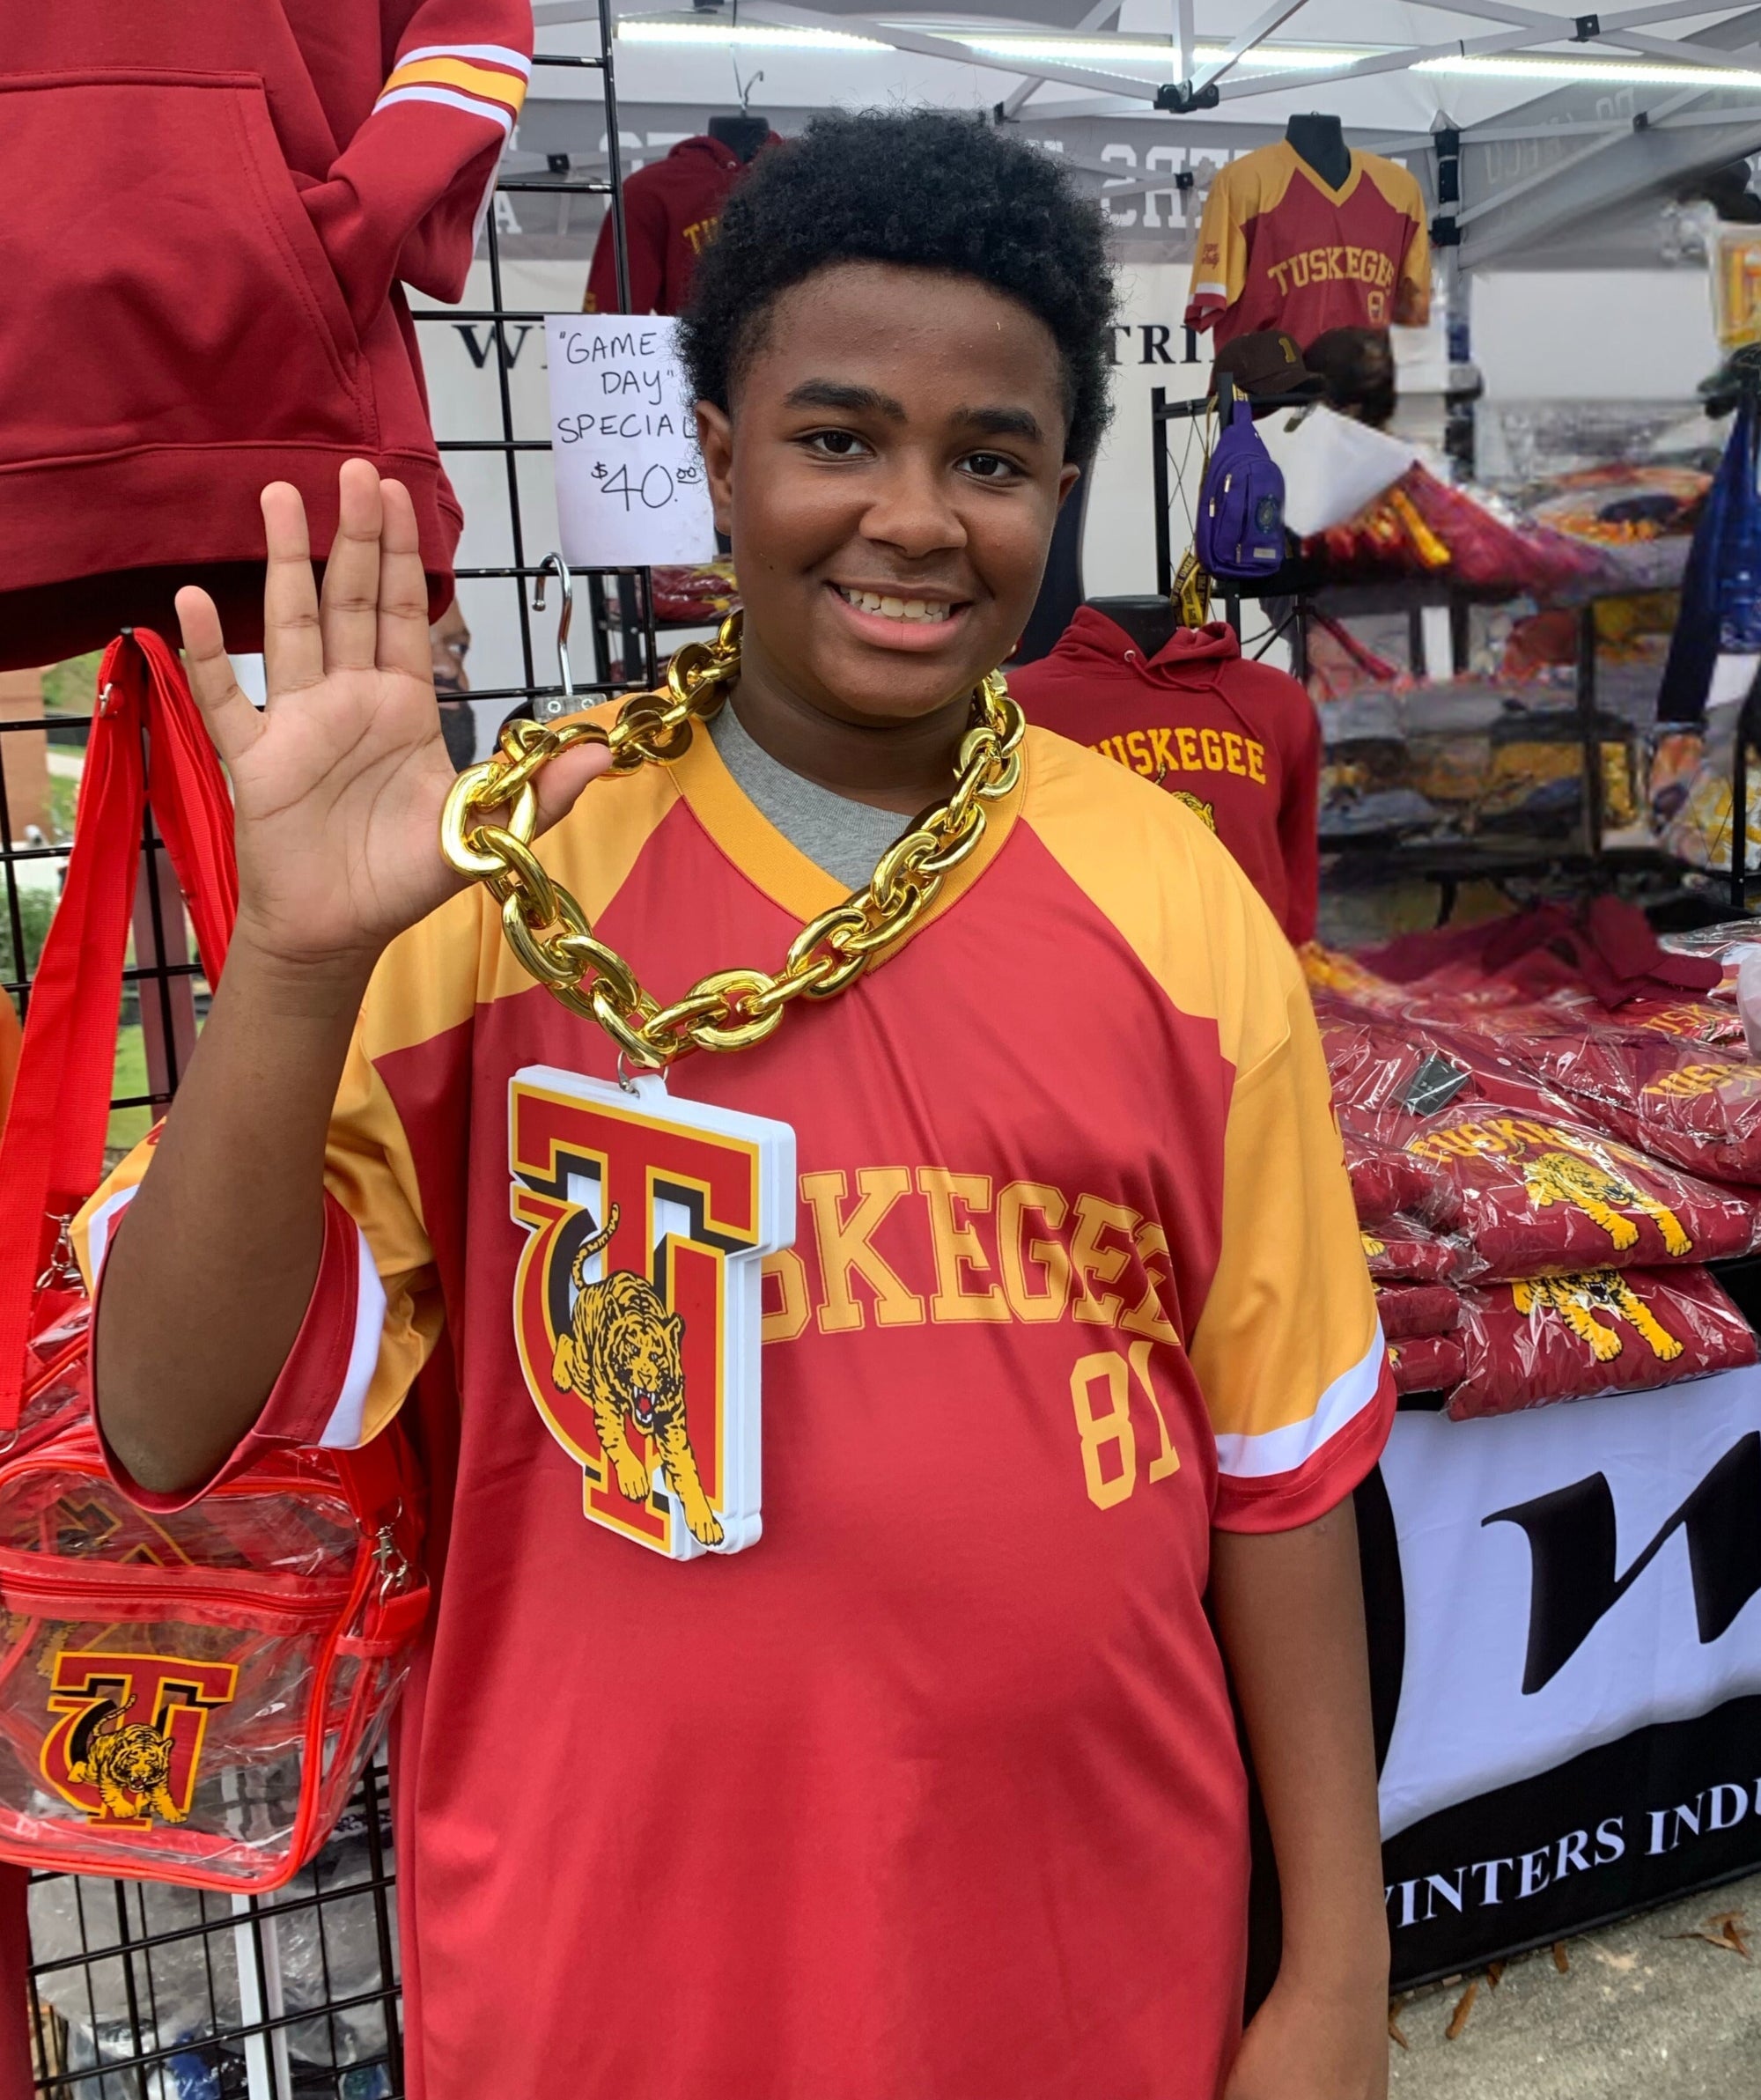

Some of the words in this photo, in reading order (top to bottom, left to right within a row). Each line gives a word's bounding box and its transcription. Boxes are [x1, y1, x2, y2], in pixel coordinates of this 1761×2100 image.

[556, 413, 699, 444] SPECIAL
[1087, 727, 1267, 785] USKEGEE
[1069, 1340, 1178, 1511] 81
[1384, 1816, 1625, 1928] INTERS
